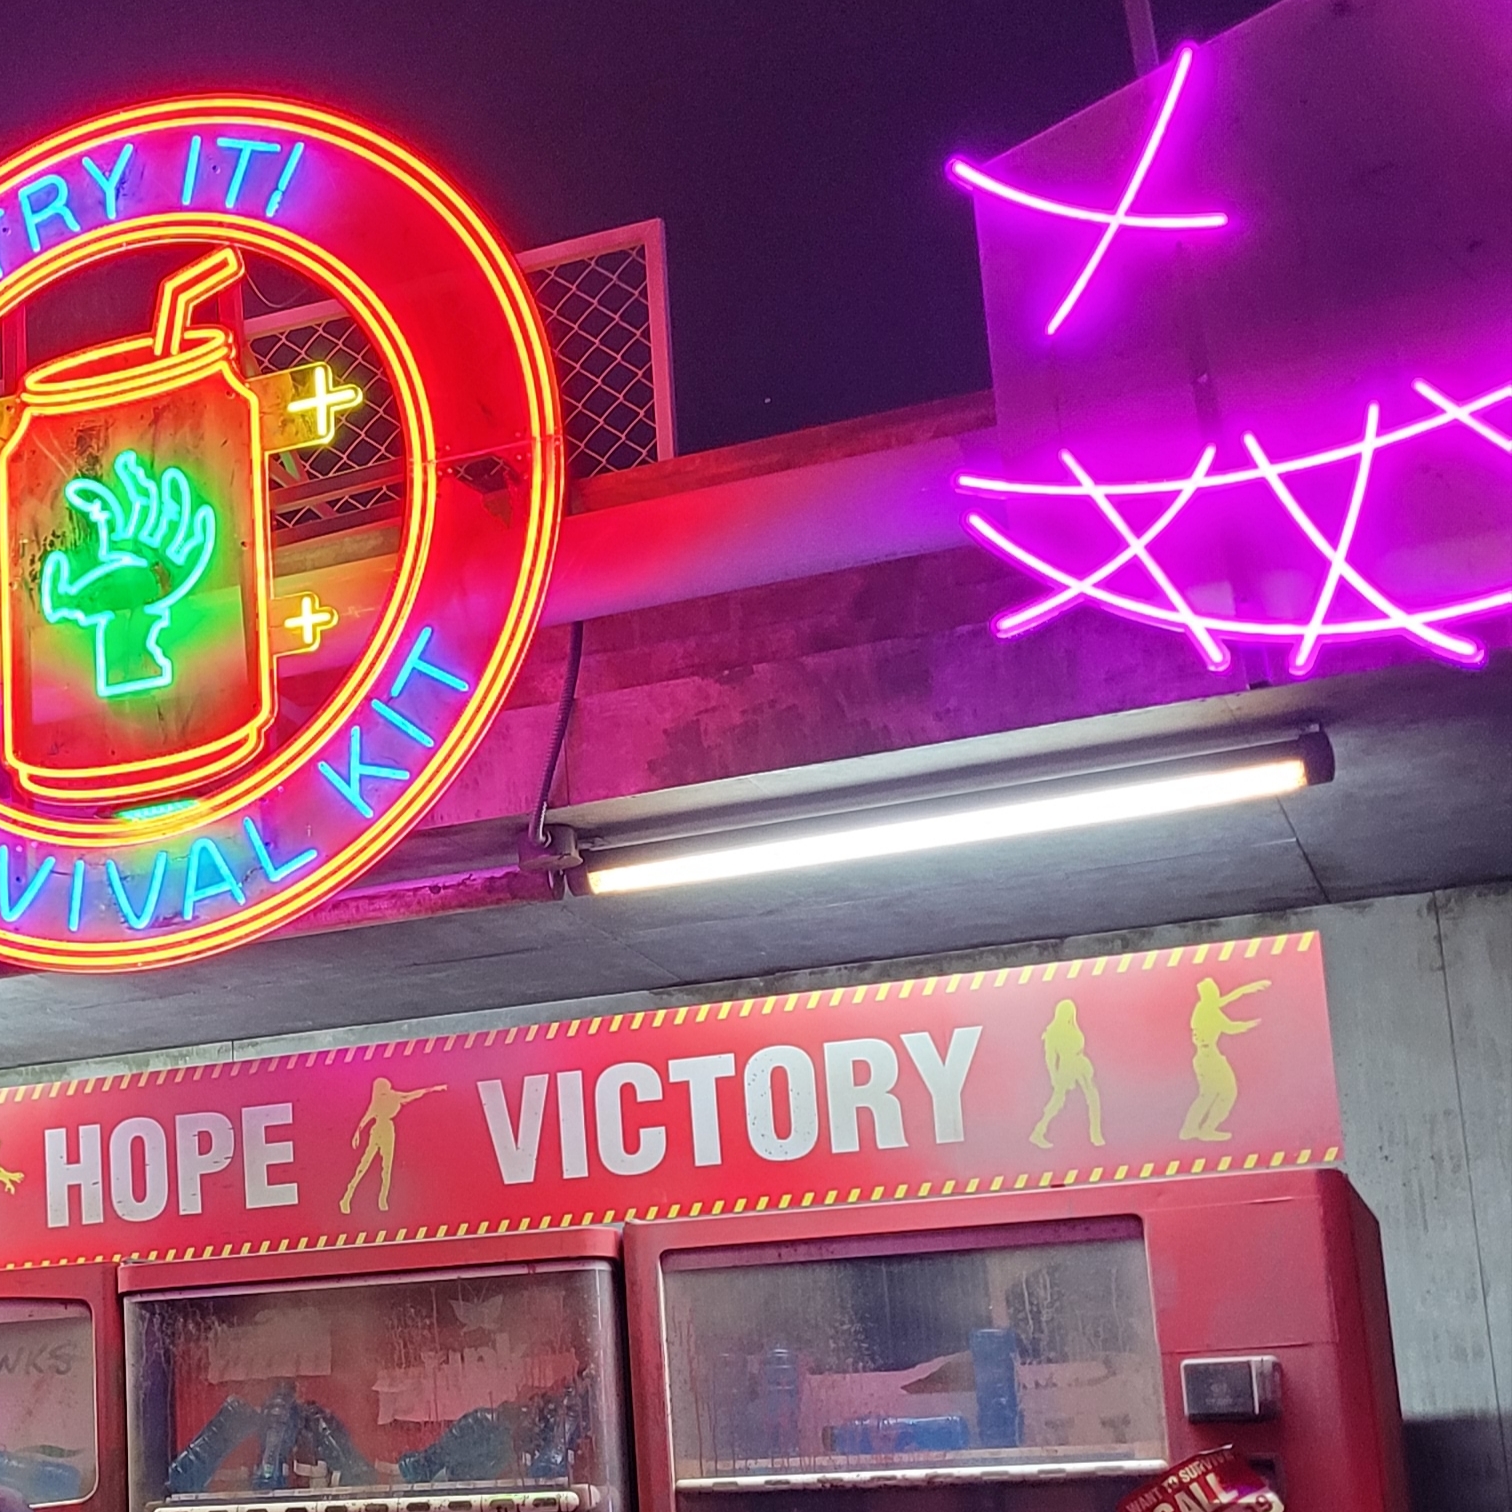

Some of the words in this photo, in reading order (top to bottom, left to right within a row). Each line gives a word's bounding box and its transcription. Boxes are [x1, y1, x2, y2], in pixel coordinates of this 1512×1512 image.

[182, 135, 306, 217] IT!
[319, 627, 471, 820] KIT
[44, 1101, 299, 1229] HOPE
[477, 1026, 983, 1187] VICTORY
